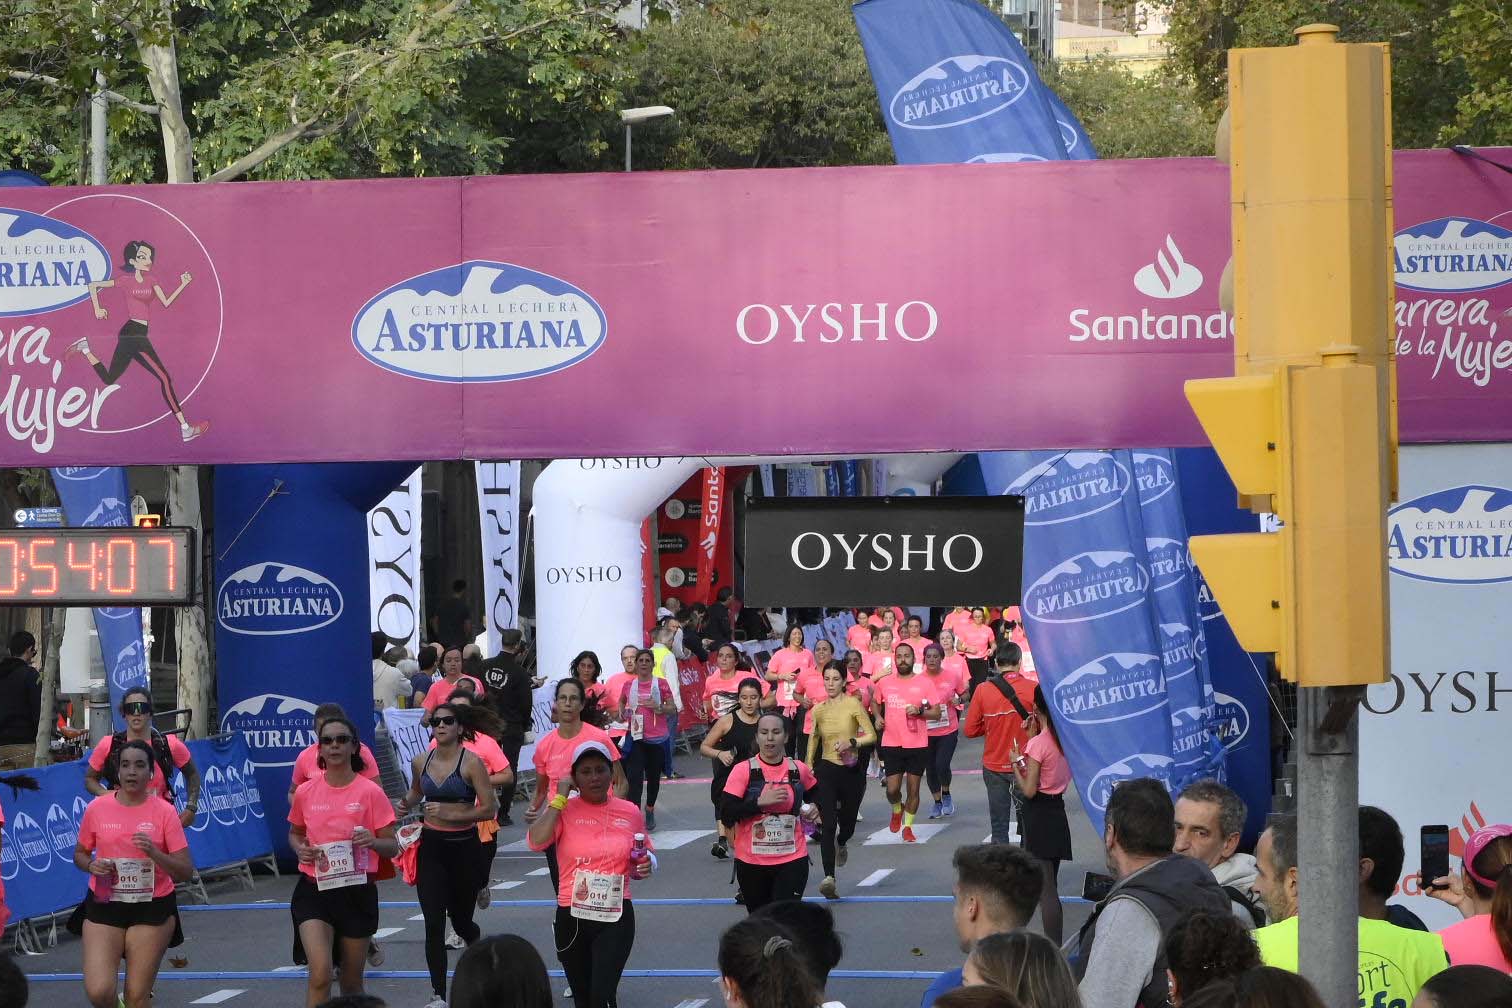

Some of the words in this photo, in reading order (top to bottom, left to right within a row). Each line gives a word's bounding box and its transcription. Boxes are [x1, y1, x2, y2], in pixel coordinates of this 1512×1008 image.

[14, 244, 86, 256] LECHERA
[1409, 242, 1458, 251] CENTRAL
[412, 305, 490, 317] CENTRAL
[498, 301, 578, 314] LECHERA
[1395, 299, 1489, 327] arrera
[372, 308, 587, 353] ASTURIANA
[736, 301, 938, 345] OYSHO
[1418, 329, 1435, 355] la
[1415, 520, 1482, 530] CENTRAL
[791, 531, 983, 573] OYSHO
[547, 565, 621, 584] OYSHO
[233, 586, 276, 596] CENTRAL
[280, 587, 329, 596] LECHERA
[221, 594, 333, 619] ASTURIANA
[491, 672, 503, 681] BP
[331, 859, 347, 867] 016
[576, 857, 591, 865] TU
